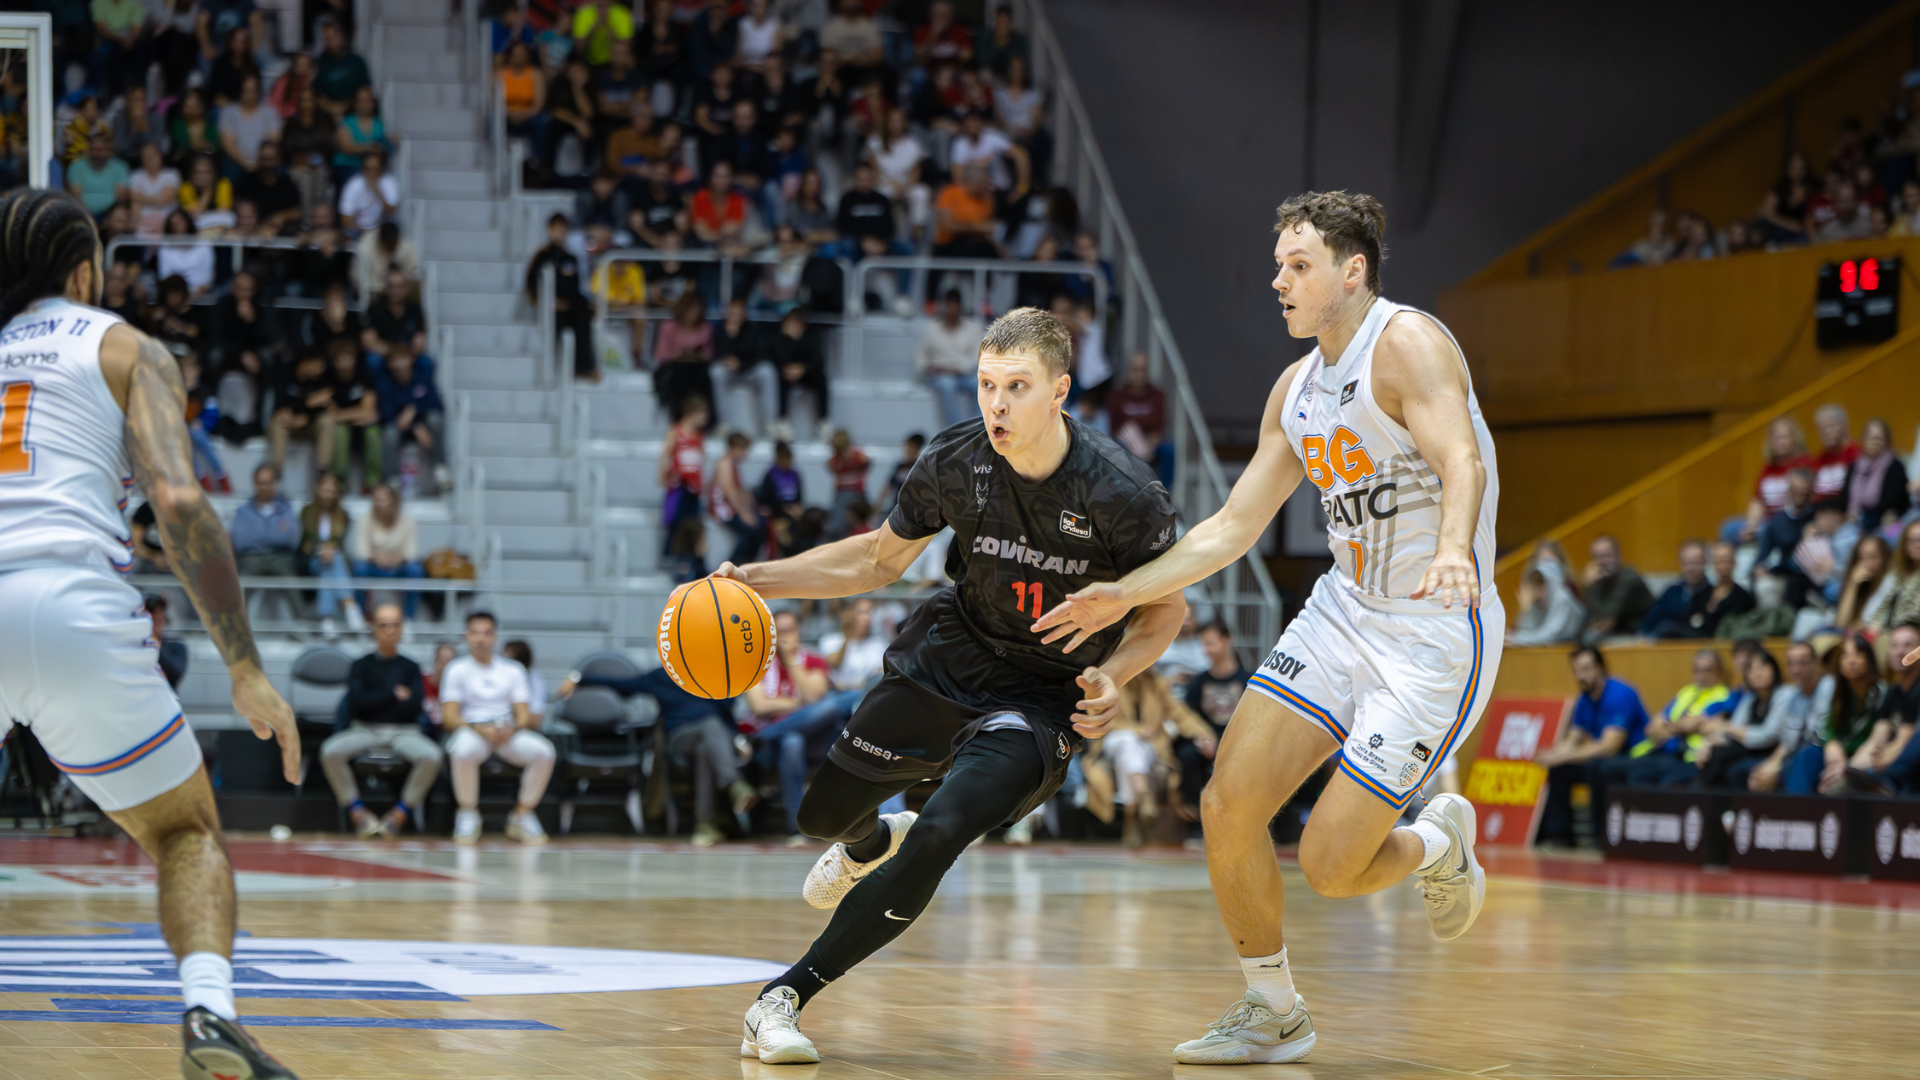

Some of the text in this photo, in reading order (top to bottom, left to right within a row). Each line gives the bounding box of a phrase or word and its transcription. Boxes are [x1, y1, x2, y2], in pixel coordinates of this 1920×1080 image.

[1839, 258, 1880, 292] 96
[1300, 424, 1378, 491] BG
[1011, 581, 1043, 620] 11
[740, 620, 754, 654] acb
[852, 736, 892, 760] asisa
[1413, 747, 1426, 760] acb
[1369, 760, 1388, 773] Girona
